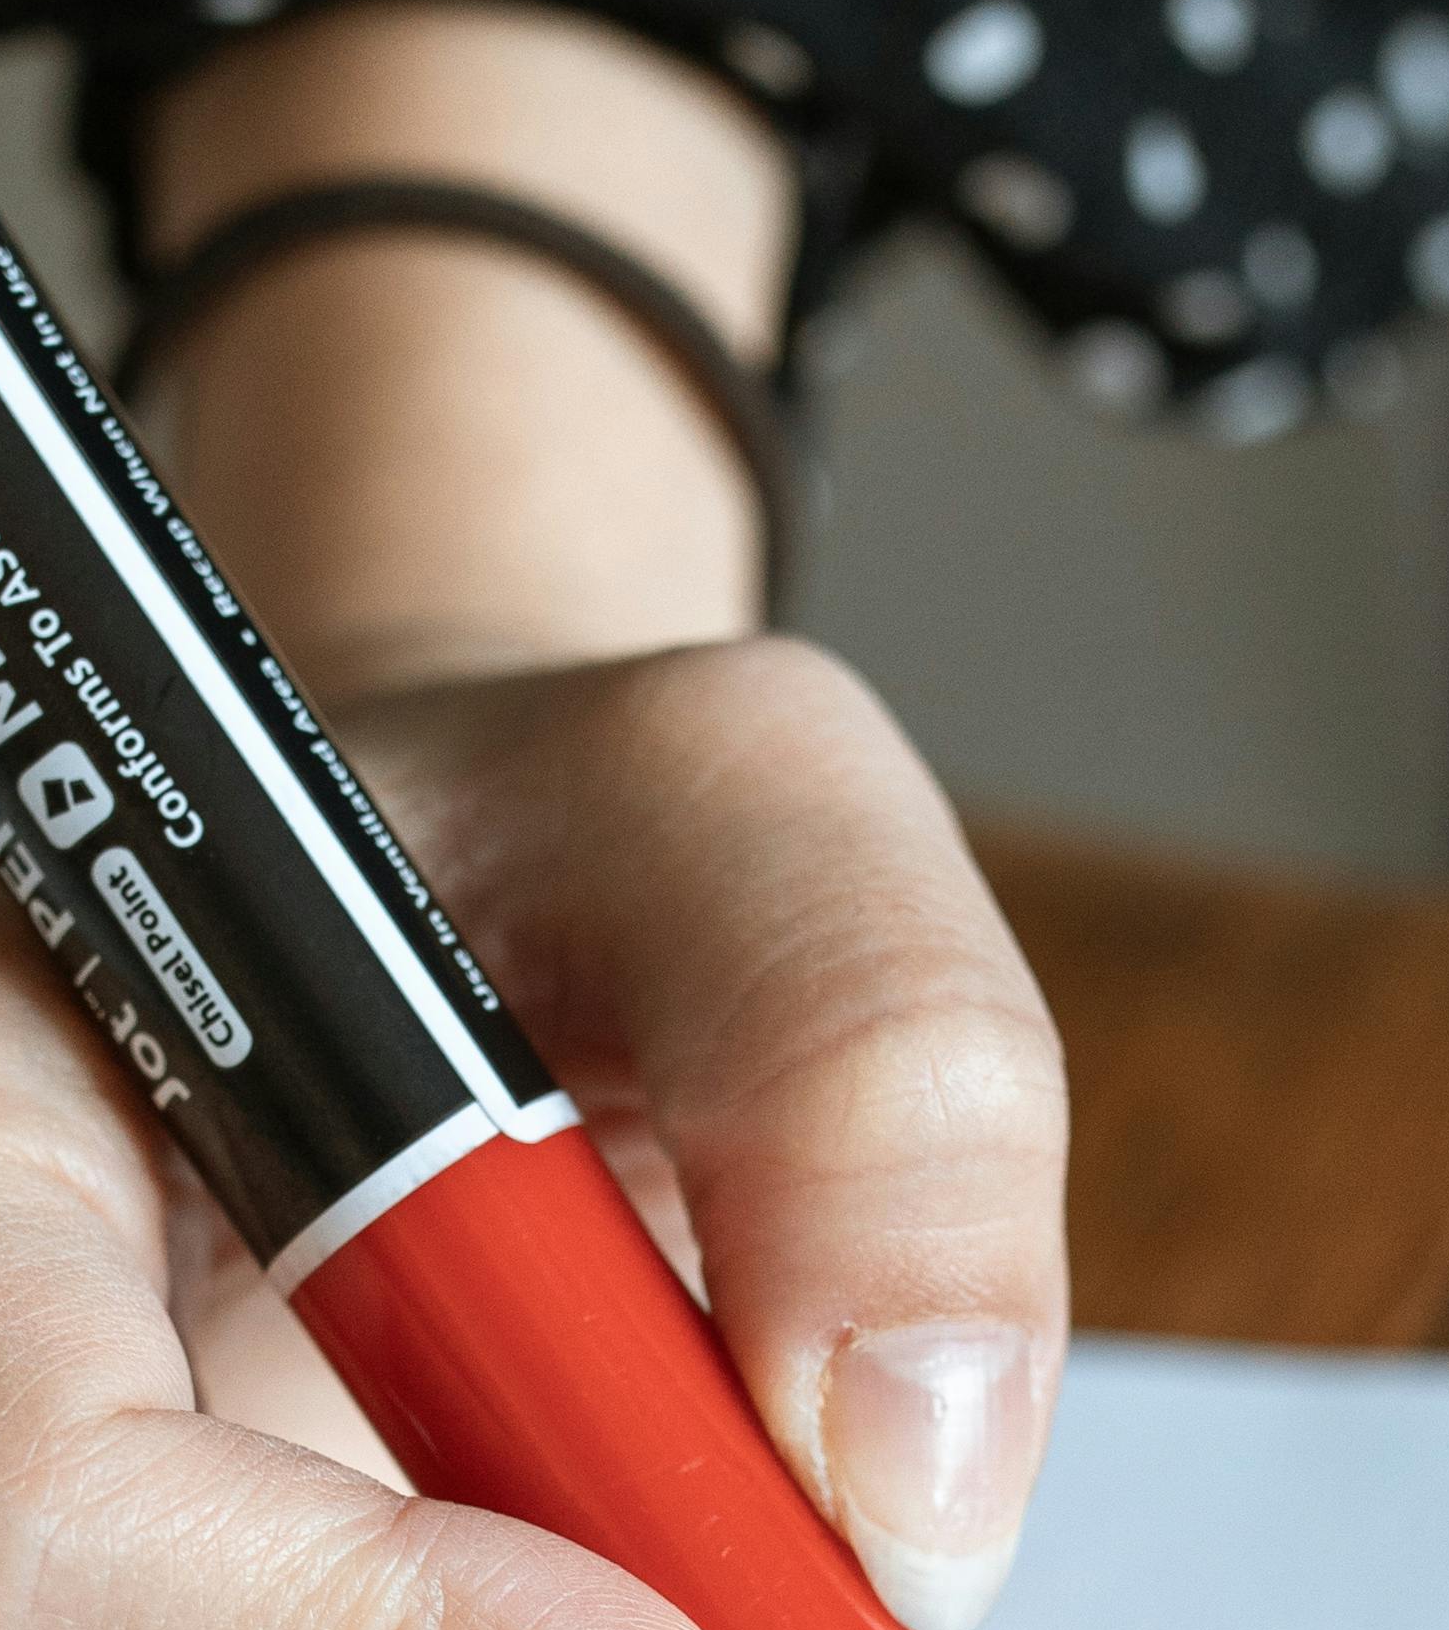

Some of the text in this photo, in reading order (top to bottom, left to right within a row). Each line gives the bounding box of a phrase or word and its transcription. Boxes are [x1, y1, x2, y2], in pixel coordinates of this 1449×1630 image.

[34, 314, 61, 346] In
[57, 354, 104, 413] Not
[103, 419, 168, 515] When
[168, 519, 238, 616] Recap
[30, 609, 71, 666] To
[261, 659, 317, 733] Area
[64, 658, 203, 847] Conforms
[312, 741, 428, 908] Ventilated
[109, 867, 233, 1048] Chisel Point
[430, 911, 455, 944] In
[455, 951, 498, 1010] Use
